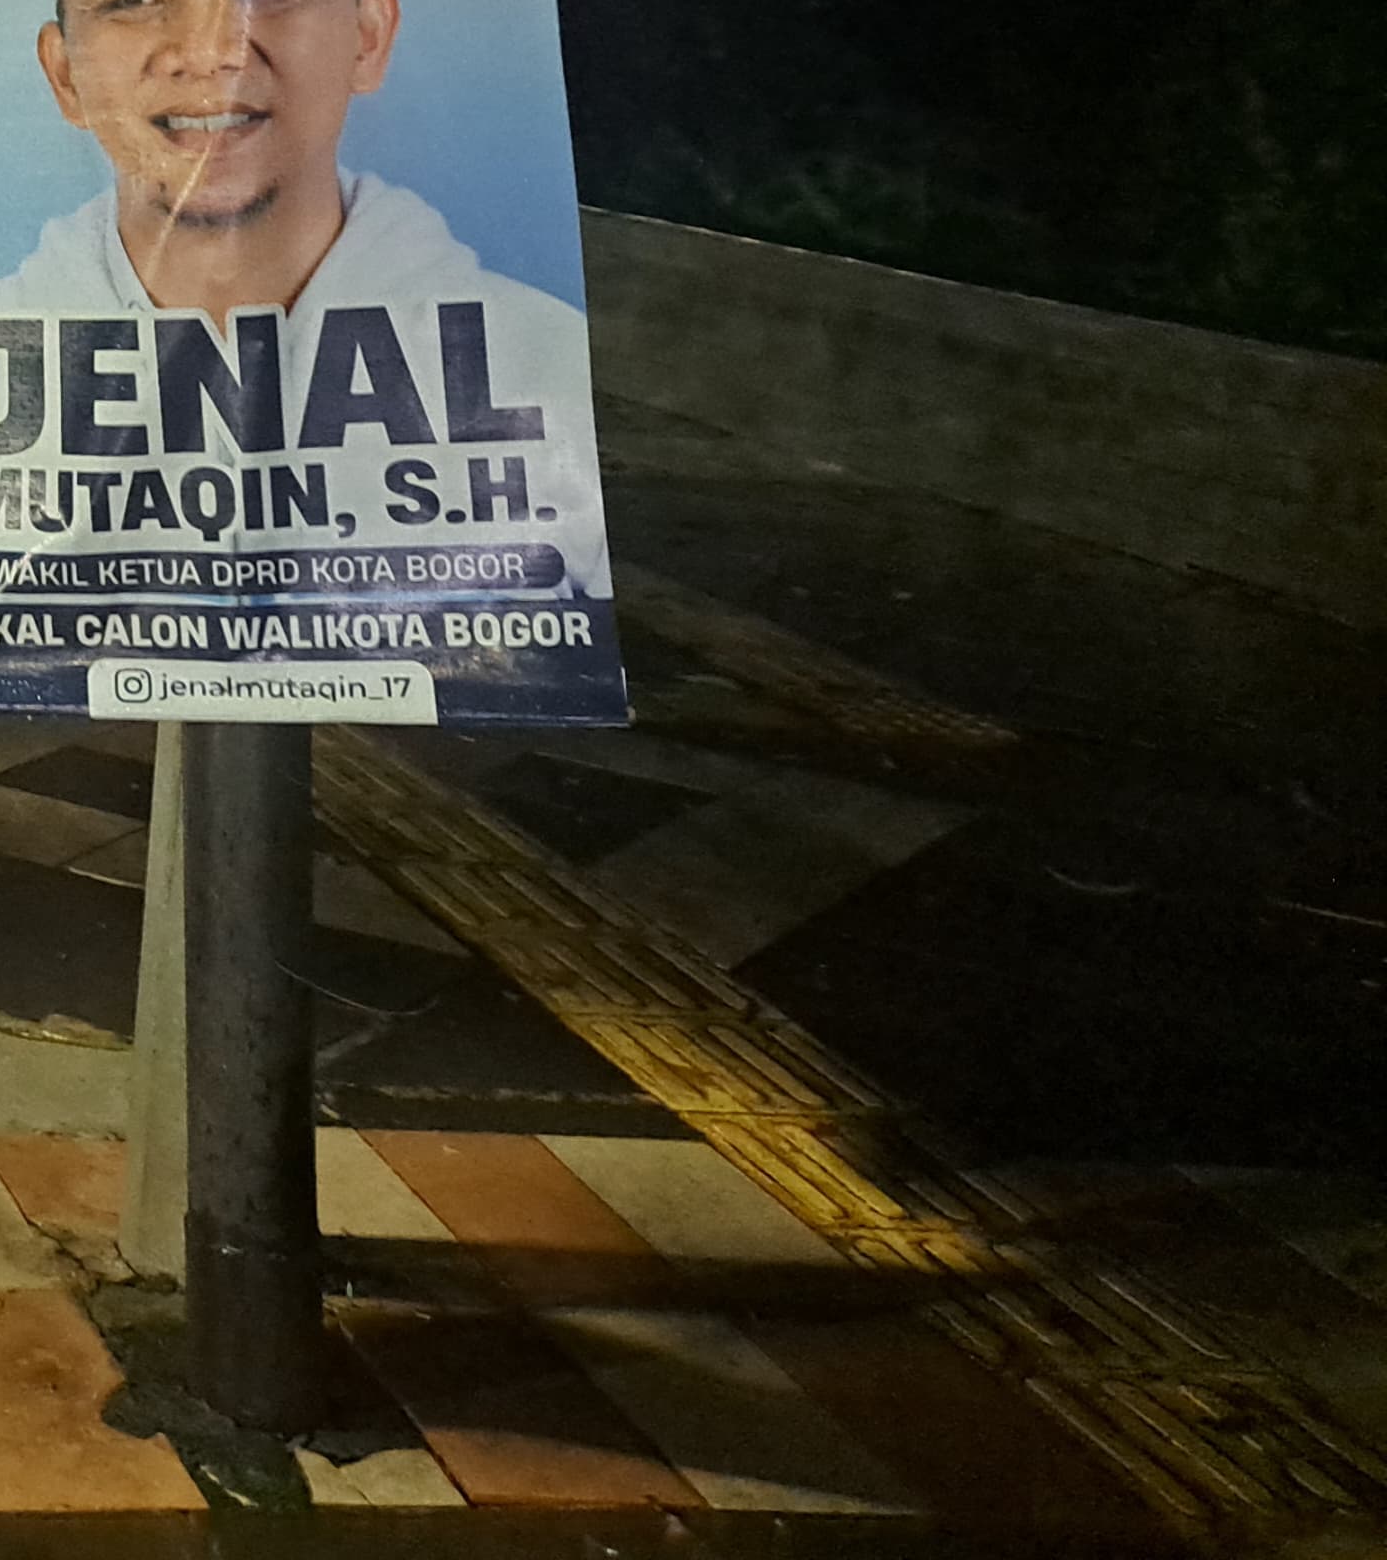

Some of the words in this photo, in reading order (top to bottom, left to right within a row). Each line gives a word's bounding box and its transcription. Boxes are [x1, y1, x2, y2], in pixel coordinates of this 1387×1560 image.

[384, 456, 558, 526] S.H.
[99, 558, 202, 587] KETUA
[212, 558, 300, 588] DPRD
[311, 556, 395, 584] KOTA
[406, 552, 525, 583] BOGOR
[75, 612, 209, 649] CALON
[220, 612, 433, 651] WALIKOTA
[443, 610, 594, 648] BOGOR
[159, 672, 412, 703] jenalmutaqin_17
